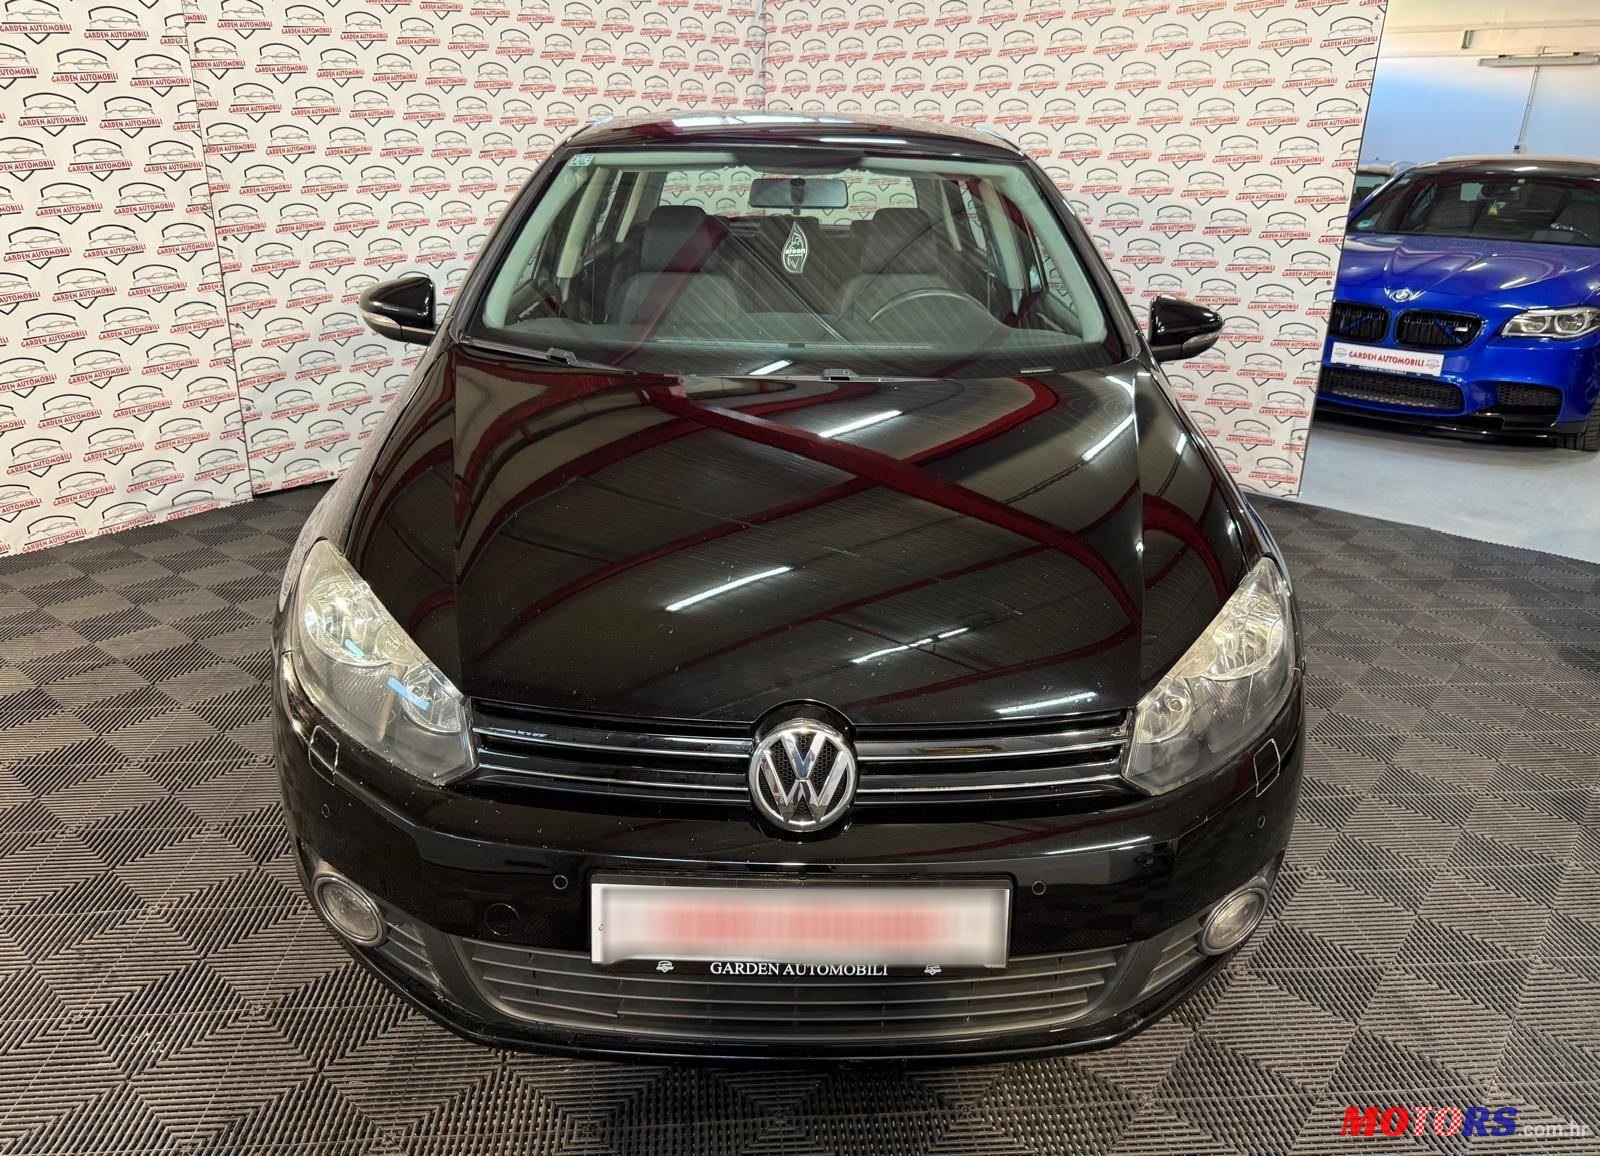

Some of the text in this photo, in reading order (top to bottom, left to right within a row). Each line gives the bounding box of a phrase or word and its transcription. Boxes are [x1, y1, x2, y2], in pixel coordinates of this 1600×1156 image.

[1176, 0, 1227, 16] GARDEN AUTOMOBILI
[1200, 38, 1251, 52] GARDEN AUTOMOBILI
[1258, 36, 1312, 51] GARDEN AUTOMOBILI
[1320, 36, 1378, 49] GARDEN AUTOMOBILI
[213, 59, 246, 68] AUTOMOBILI
[277, 64, 308, 72] AUTOMOBILI
[0, 68, 39, 76] UTOMOBILI
[52, 73, 118, 83] GARDEN AUTOMOBILI
[156, 77, 192, 85] AUTOMOBILI
[1223, 77, 1275, 90] GARDEN AUTOMOBILI
[1282, 77, 1338, 90] GARDEN AUTOMOBILI
[229, 104, 282, 114] GARDEN AUTOMOBILI
[291, 106, 342, 117] GARDEN AUTOMOBILI
[18, 116, 88, 127] GARDEN AUTOMOBILI
[99, 118, 163, 130] GARDEN AUTOMOBILI
[1246, 116, 1300, 128] GARDEN AUTOMOBILI
[1307, 116, 1363, 129] GARDEN AUTOMOBILI
[266, 144, 317, 156] GARDEN AUTOMOBILI
[14, 160, 55, 170] AUTOMOBILI
[1212, 154, 1263, 164] GARDEN AUTOMOBILI
[1270, 156, 1325, 167] GARDEN AUTOMOBILI
[68, 160, 133, 174] GARDEN AUTOMOBILI
[144, 160, 203, 174] GARDEN AUTOMOBILI
[240, 183, 292, 196] GARDEN AUTOMOBILI
[301, 182, 349, 196] GARDEN AUTOMOBILI
[1256, 192, 1288, 200] AUTOMOBILI
[36, 202, 103, 217] GARDEN AUTOMOBILI
[114, 202, 176, 215] GARDEN AUTOMOBILI
[216, 221, 267, 236] ARDEN AUTOMOBILI
[275, 220, 326, 234] GARDEN AUTOMOBILI
[3, 247, 72, 262] GARDEN AUTOMOBILI
[83, 244, 146, 259] GARDEN AUTOMOBILI
[157, 240, 215, 256] GARDEN AUTOMOBILI
[251, 259, 301, 274] GARDEN AUTOMOBILI
[309, 256, 356, 270] GARDEN AUTOMOBILI
[1304, 270, 1335, 278] AUTOMOBILI
[52, 285, 117, 303] GARDEN AUTOMOBILI
[128, 281, 188, 298] GARDEN AUTOMOBILI
[197, 283, 219, 292] GARDEN
[98, 323, 160, 341] GARDEN AUTOMOBILI
[170, 317, 226, 335] GARDEN AUTOMOBILI
[21, 336, 46, 349] GARDEN
[48, 329, 88, 344] AUTOMOBILI
[261, 331, 311, 350] GARDEN AUTOMOBILI
[1349, 351, 1424, 366] GARDEN AUTOMOBILI
[142, 358, 200, 376] GARDEN AUTOMOBILI
[16, 374, 57, 388] AUTOMOBILI
[68, 364, 131, 386] GARDEN AUTOMOBILI
[1257, 371, 1287, 379] AUTOMOBILI
[182, 391, 237, 410] GARDEN AUTOMOBILI
[113, 398, 172, 420] GARDEN AUTOMOBILI
[1279, 409, 1308, 417] AUTOMOBILI
[38, 408, 102, 430] GARDEN AUTOMOBILI
[155, 430, 210, 452] GARDEN AUTOMOBILI
[1245, 437, 1275, 445] AUTOMOBILI
[83, 440, 144, 464] GARDEN AUTOMOBILI
[6, 452, 72, 476] GARDEN AUTOMOBILI
[194, 462, 246, 483] GARDEN AUTOMOBILI
[126, 472, 184, 494] GARDEN AUTOMOBILI
[53, 484, 116, 508] GARDEN AUTOMOBILI
[2, 499, 42, 513] AUTOMOBILI
[23, 527, 86, 555] GARDEN AUTOMOBILI
[710, 962, 888, 976] GARDEN AUTOMOBILI
